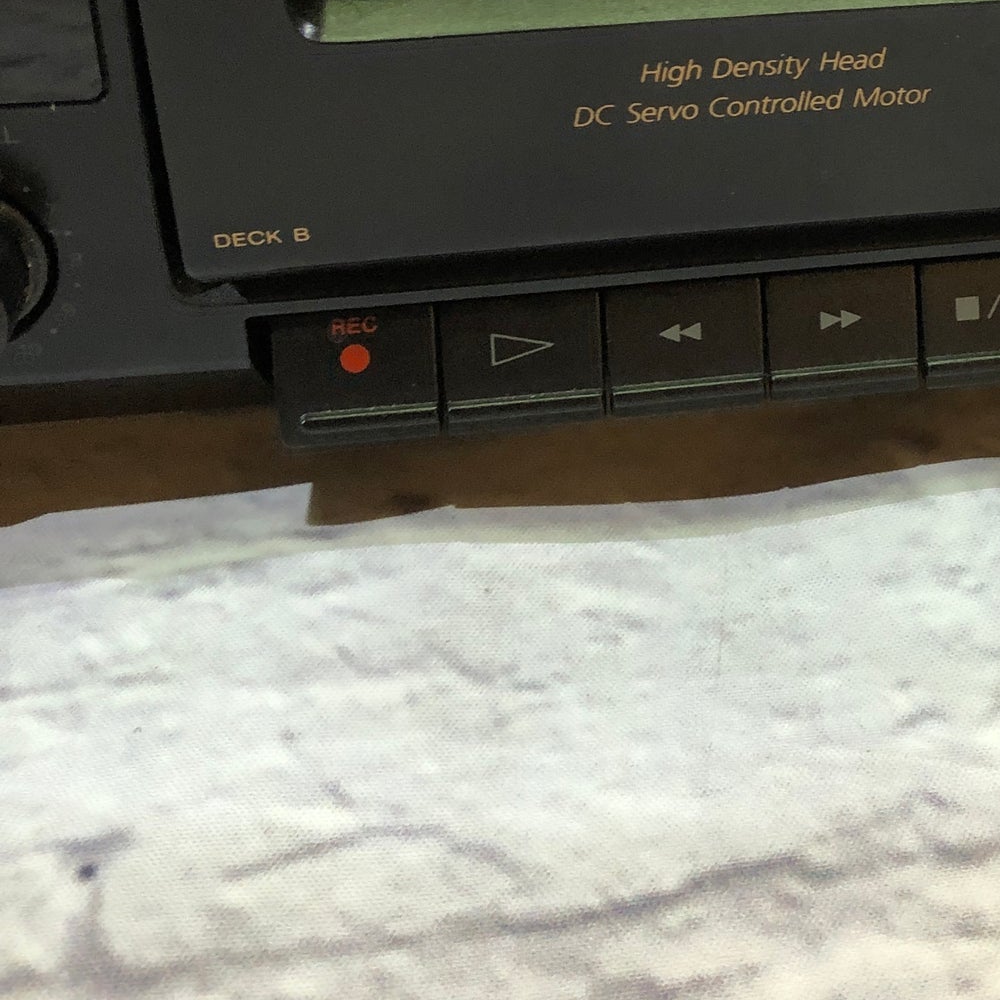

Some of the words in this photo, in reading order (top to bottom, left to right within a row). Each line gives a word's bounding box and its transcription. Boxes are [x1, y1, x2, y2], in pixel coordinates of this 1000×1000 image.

[640, 59, 701, 88] High
[711, 53, 810, 80] Density
[819, 46, 887, 72] Head
[573, 104, 616, 128] DC
[626, 101, 699, 125] Servo
[708, 88, 844, 119] Controlled
[853, 85, 932, 109] Motor
[213, 229, 283, 249] DECK
[293, 227, 312, 243] B
[330, 316, 378, 337] REC
